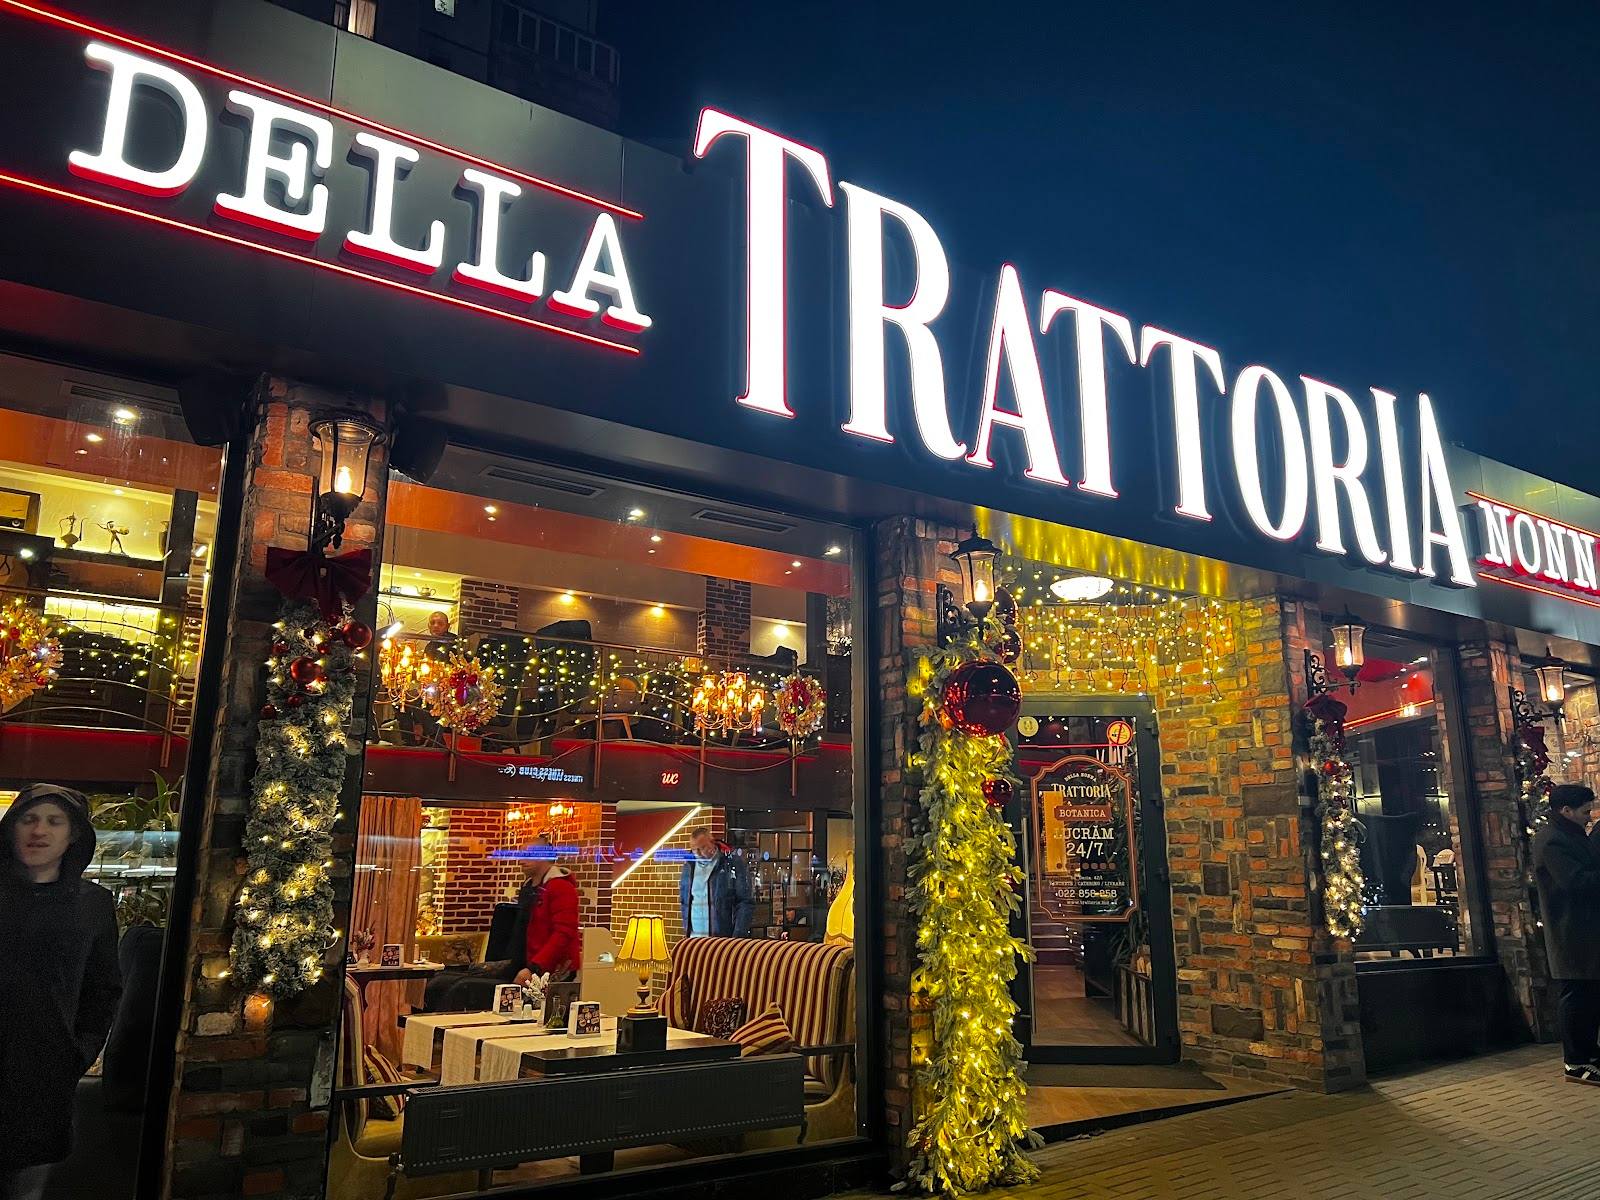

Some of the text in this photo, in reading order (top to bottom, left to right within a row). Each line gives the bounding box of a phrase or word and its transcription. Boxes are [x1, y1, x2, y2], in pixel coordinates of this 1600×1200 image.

[68, 42, 652, 330] DELLA
[694, 106, 1477, 588] TRATTORIA
[661, 772, 679, 785] WC
[1051, 783, 1111, 798] TRATTORIA
[1059, 809, 1106, 818] BOTANICA
[1066, 841, 1103, 859] 24/7
[1058, 889, 1076, 898] 022
